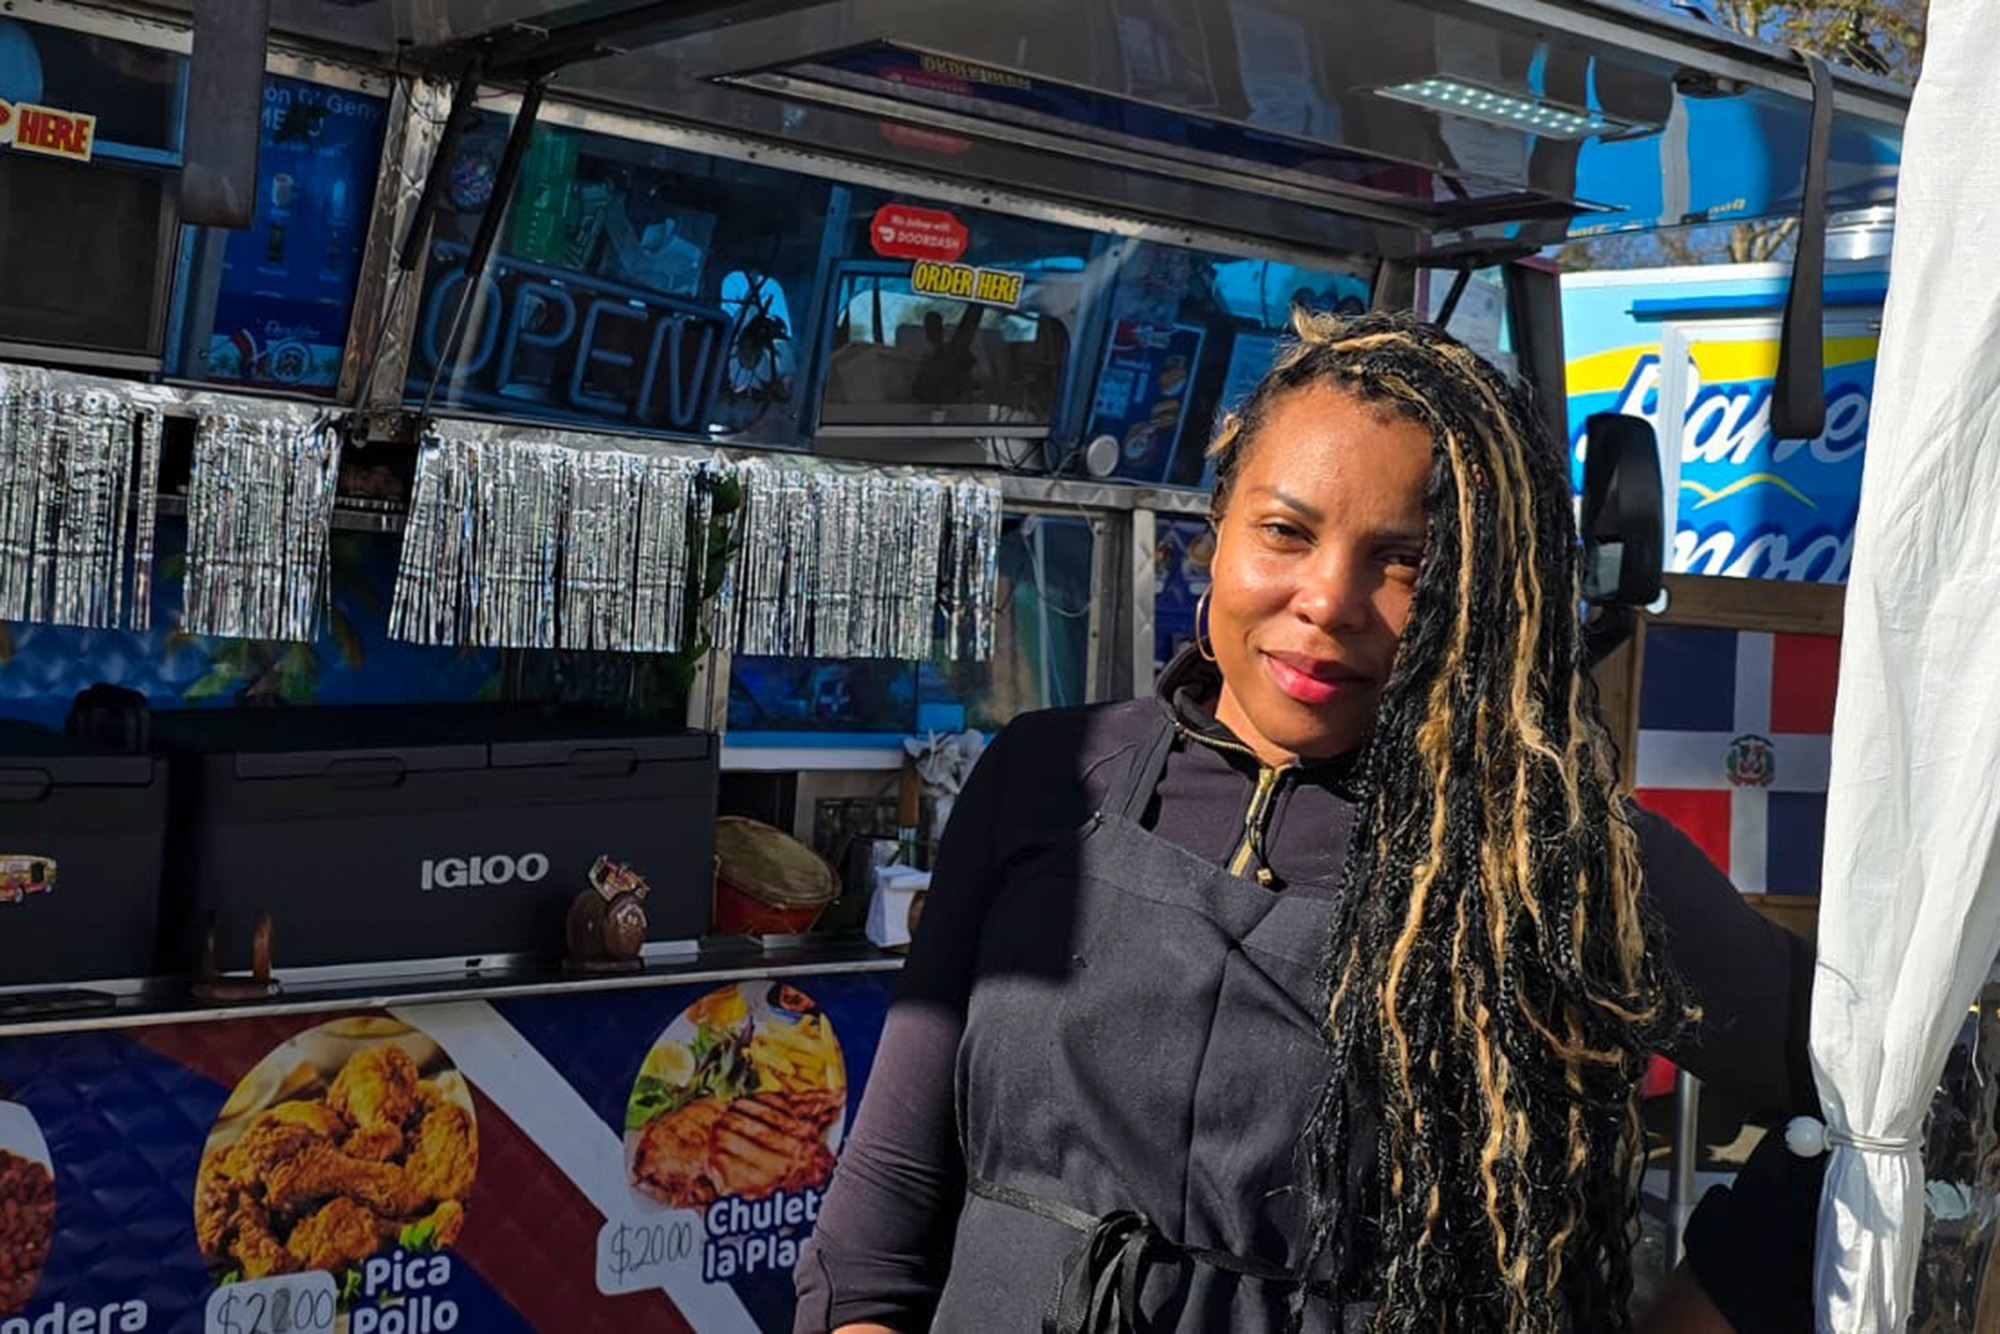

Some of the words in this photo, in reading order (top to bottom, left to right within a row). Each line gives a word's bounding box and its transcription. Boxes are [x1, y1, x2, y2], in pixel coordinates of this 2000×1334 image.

[17, 108, 91, 153] HERE
[896, 231, 960, 250] DOORDASH
[913, 262, 973, 297] ORDER
[976, 271, 1022, 305] HERE
[423, 267, 715, 425] OPEN
[420, 852, 550, 891] IGLOO
[364, 1248, 451, 1298] Pica
[705, 1242, 737, 1280] la
[746, 1234, 798, 1274] Pla
[353, 1294, 460, 1334] Pollo
